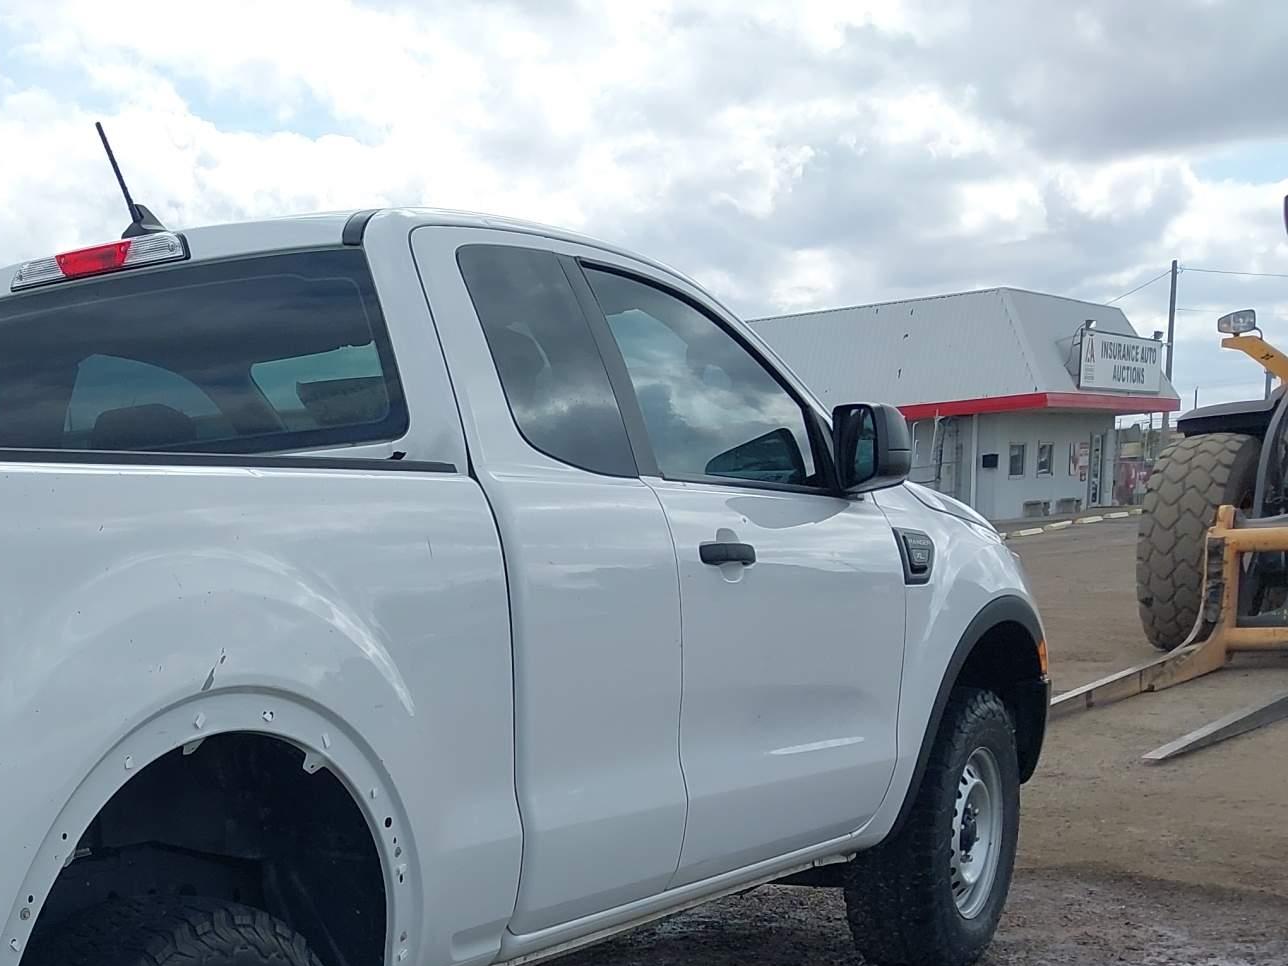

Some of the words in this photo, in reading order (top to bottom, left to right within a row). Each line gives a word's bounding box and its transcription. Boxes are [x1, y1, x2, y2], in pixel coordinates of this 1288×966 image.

[1101, 341, 1139, 361] INSURANCE
[1141, 346, 1157, 364] AUTO
[1113, 365, 1144, 384] AUCTIONS
